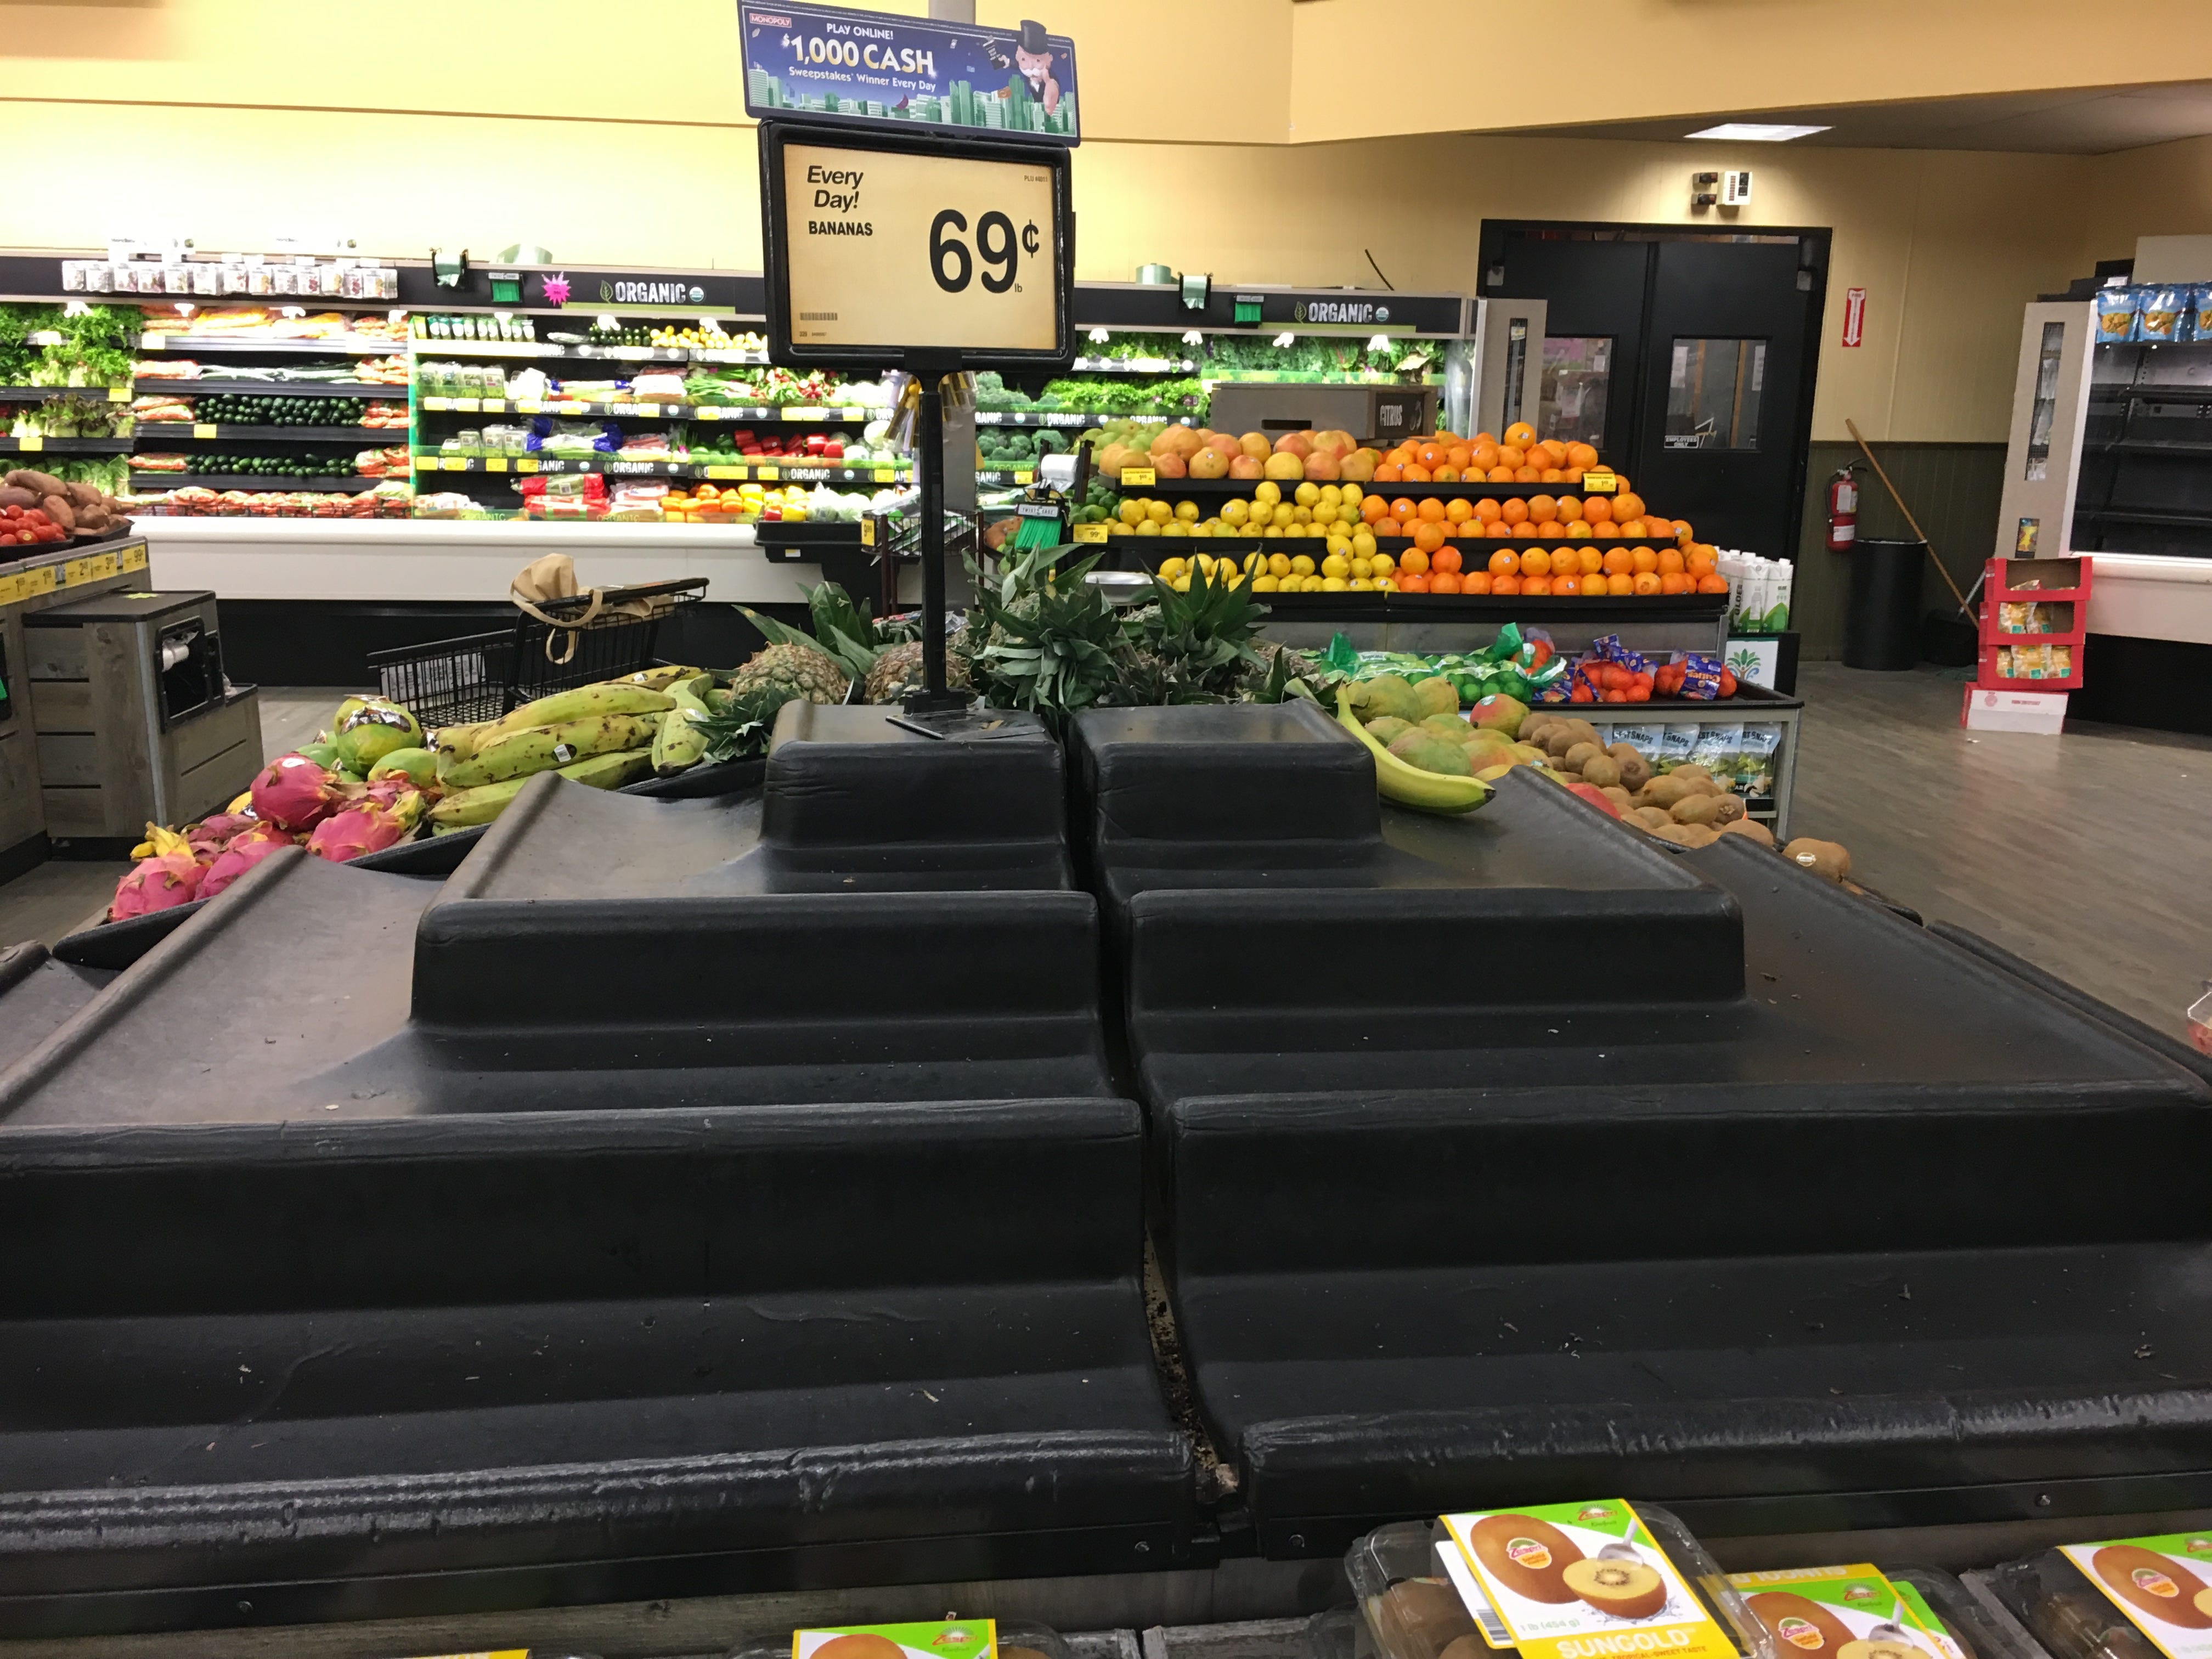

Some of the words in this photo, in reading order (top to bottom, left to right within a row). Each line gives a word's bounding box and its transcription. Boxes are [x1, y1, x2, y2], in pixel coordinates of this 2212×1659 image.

[751, 15, 790, 26] MONOPOLY
[827, 23, 850, 35] PLAY
[853, 26, 894, 40] ONLINE!
[782, 33, 859, 67] $1,000
[864, 44, 934, 74] CASH
[856, 74, 889, 86] Winner
[893, 77, 916, 91] Every
[919, 80, 936, 92] Day
[806, 165, 864, 189] Every
[814, 190, 859, 212] Day!
[809, 221, 873, 236] BANANAS
[615, 281, 686, 303] ORGANIC
[1014, 283, 1023, 293] lb
[1308, 302, 1373, 323] ORGANIC
[1046, 414, 1086, 425] ORGANIC
[1380, 404, 1403, 426] CITRUS
[538, 460, 565, 472] GANIC
[612, 462, 654, 473] ORGANIC
[790, 469, 831, 479] ORGANIC
[975, 472, 1001, 482] GANIC
[1631, 731, 1653, 744] SNAPS
[1667, 732, 1689, 747] SNAPS
[1557, 1628, 1690, 1659] SUNGOLD
